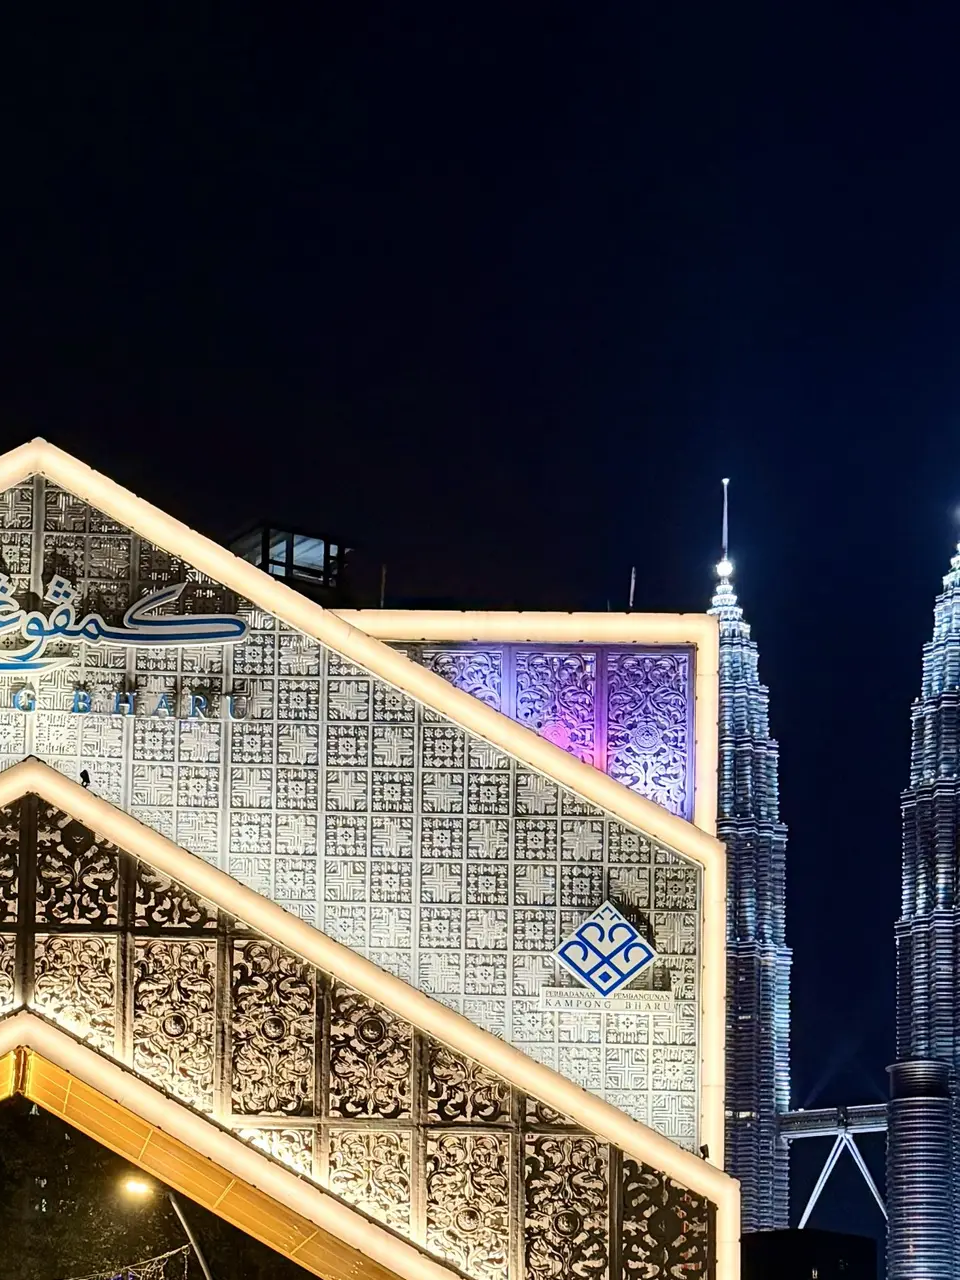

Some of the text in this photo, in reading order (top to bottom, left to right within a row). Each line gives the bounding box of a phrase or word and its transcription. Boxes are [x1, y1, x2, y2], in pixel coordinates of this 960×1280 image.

[71, 685, 253, 721] BHARU
[545, 990, 670, 1001] PERBADANAN PEMBANGUNAN
[545, 998, 671, 1011] KAMPONG BHARU
